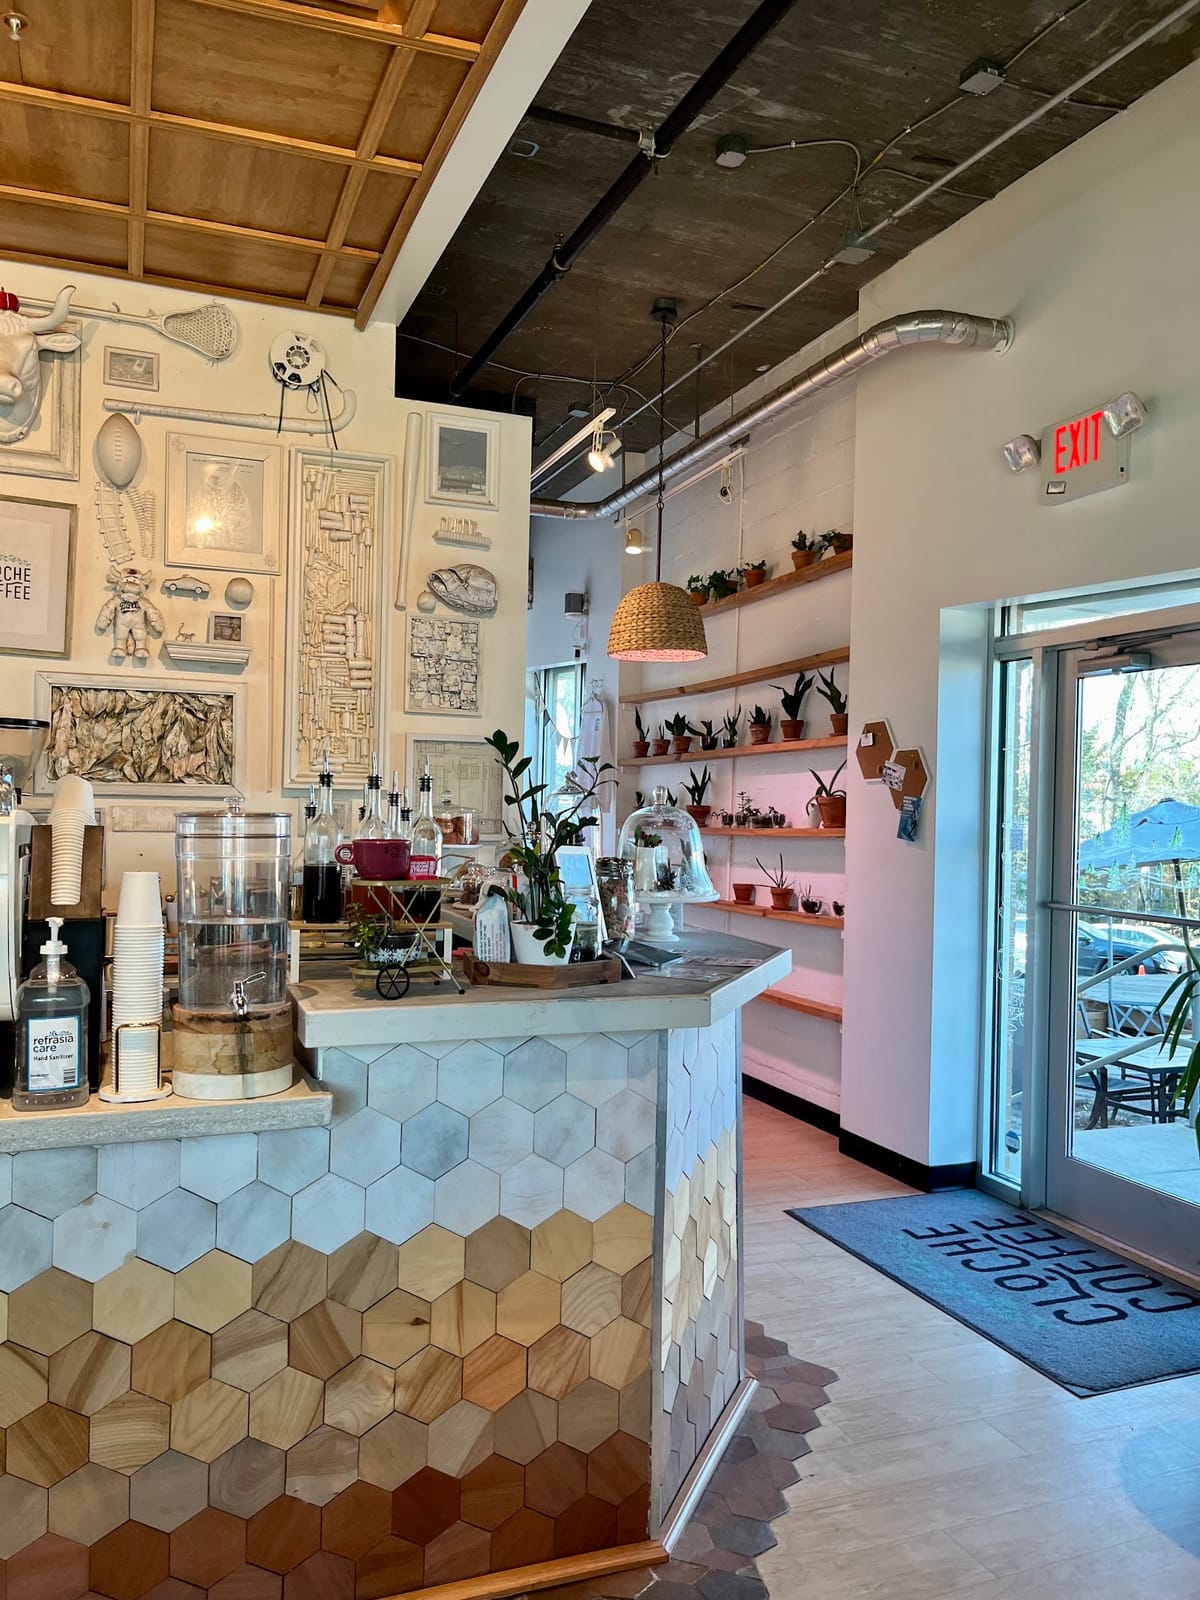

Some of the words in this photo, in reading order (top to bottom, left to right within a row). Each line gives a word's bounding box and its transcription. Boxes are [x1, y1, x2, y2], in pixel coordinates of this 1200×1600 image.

[1055, 410, 1103, 474] EXIT
[0, 566, 31, 582] CHE
[33, 1035, 74, 1045] refrasia
[33, 1045, 57, 1053] care
[902, 1223, 1129, 1326] CLOCHE
[970, 1214, 1200, 1313] COFFEE
